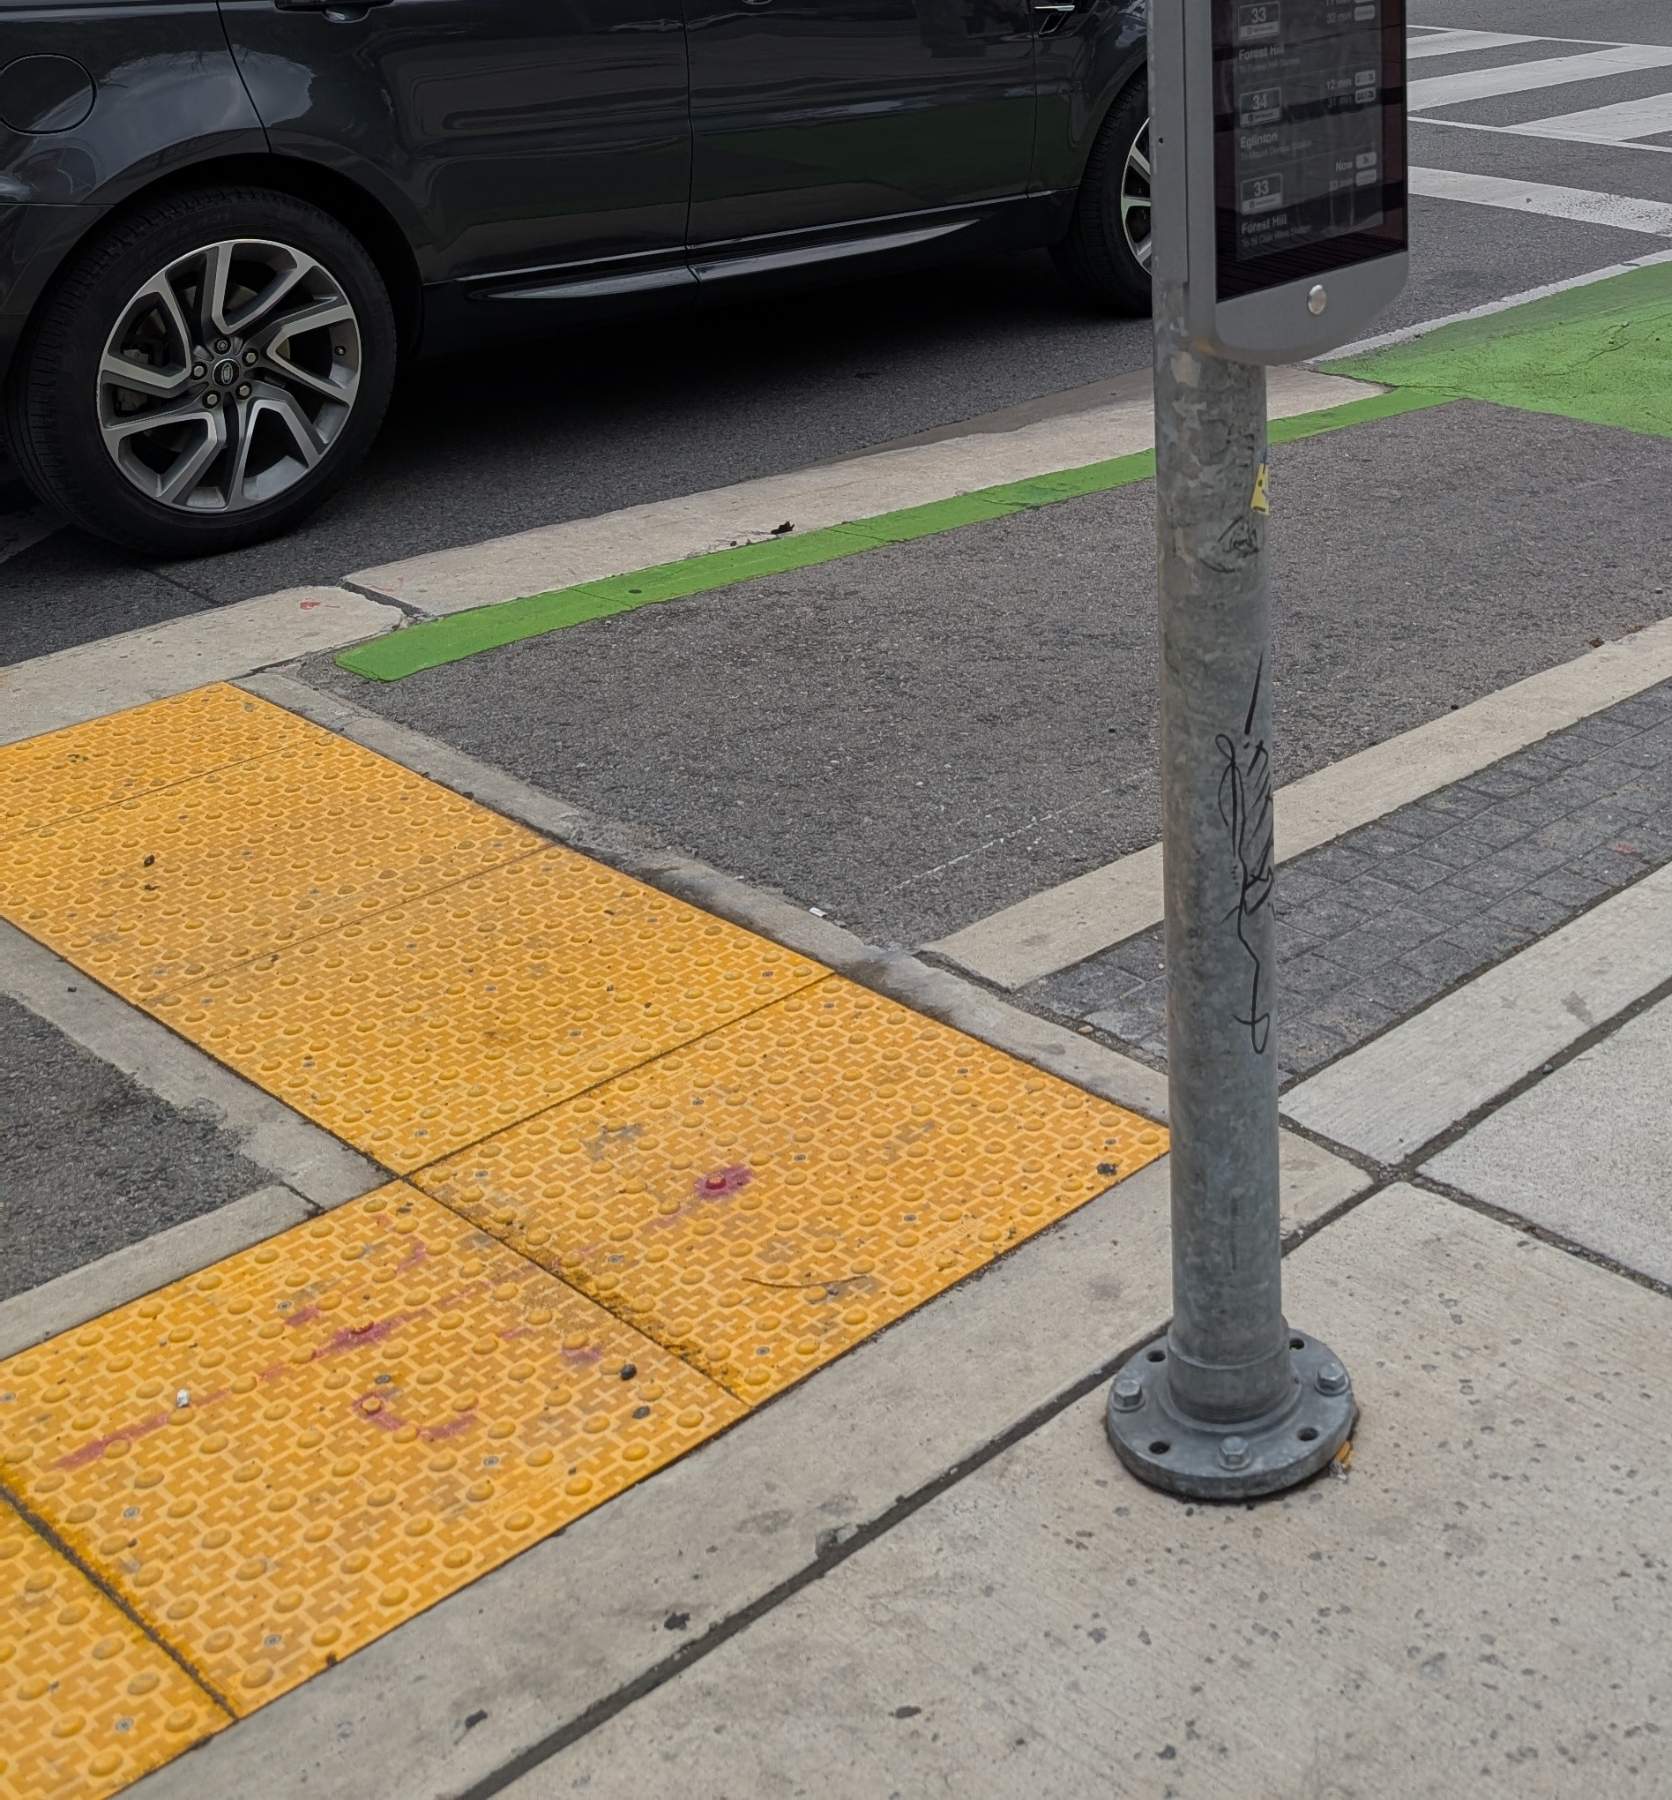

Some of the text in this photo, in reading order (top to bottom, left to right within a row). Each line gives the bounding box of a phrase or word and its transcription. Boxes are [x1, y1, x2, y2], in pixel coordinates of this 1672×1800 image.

[1251, 6, 1267, 24] 33
[1252, 93, 1268, 111] 34
[1240, 132, 1278, 149] Eglinton
[1253, 179, 1269, 197] 33
[1241, 218, 1270, 234] Forest
